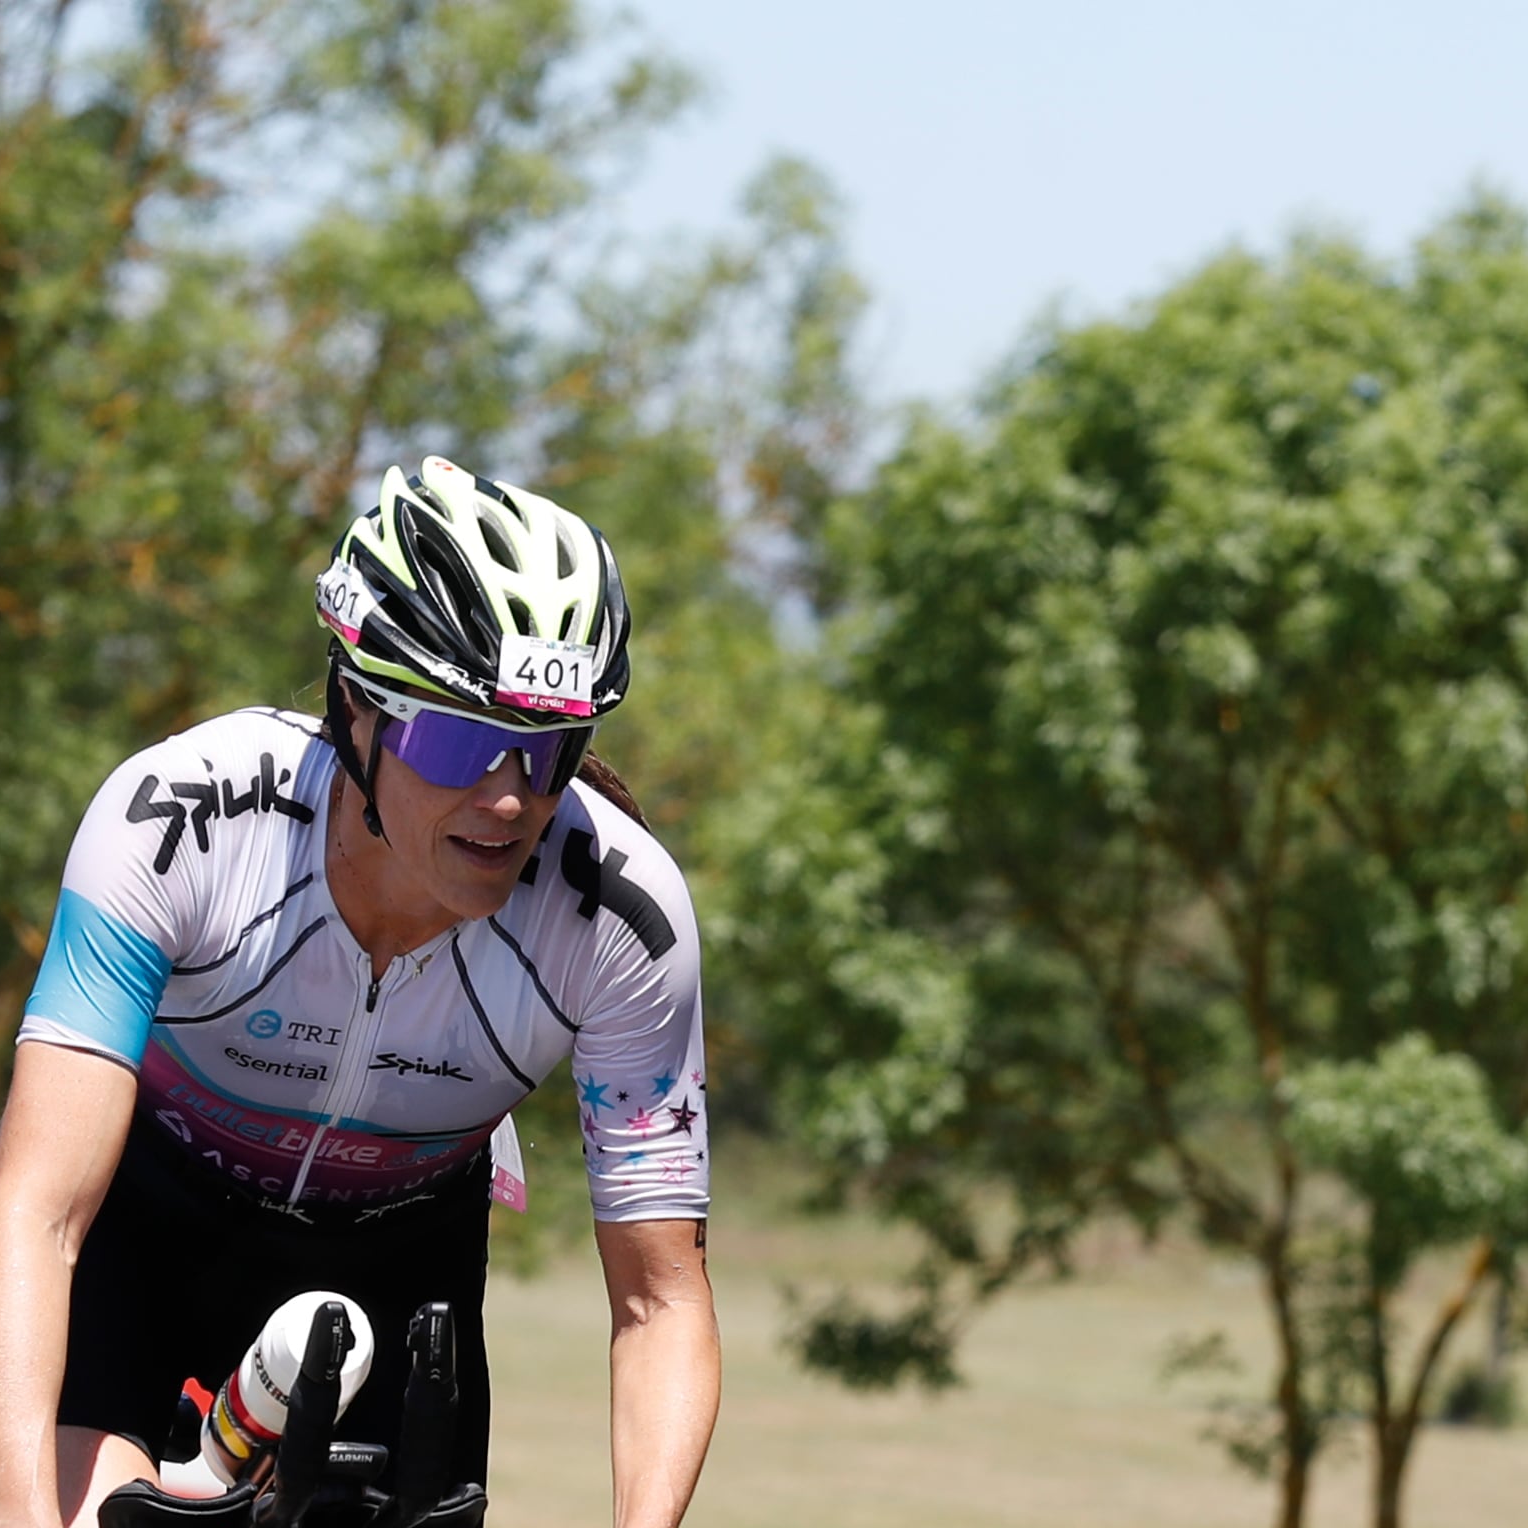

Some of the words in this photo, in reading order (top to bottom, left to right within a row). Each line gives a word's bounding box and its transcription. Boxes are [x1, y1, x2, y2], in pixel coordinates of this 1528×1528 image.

[515, 656, 579, 692] 401
[287, 1021, 342, 1046] TRI
[225, 1046, 329, 1082] esential
[369, 1053, 473, 1083] Spiuk
[329, 1452, 373, 1464] GARMIN
